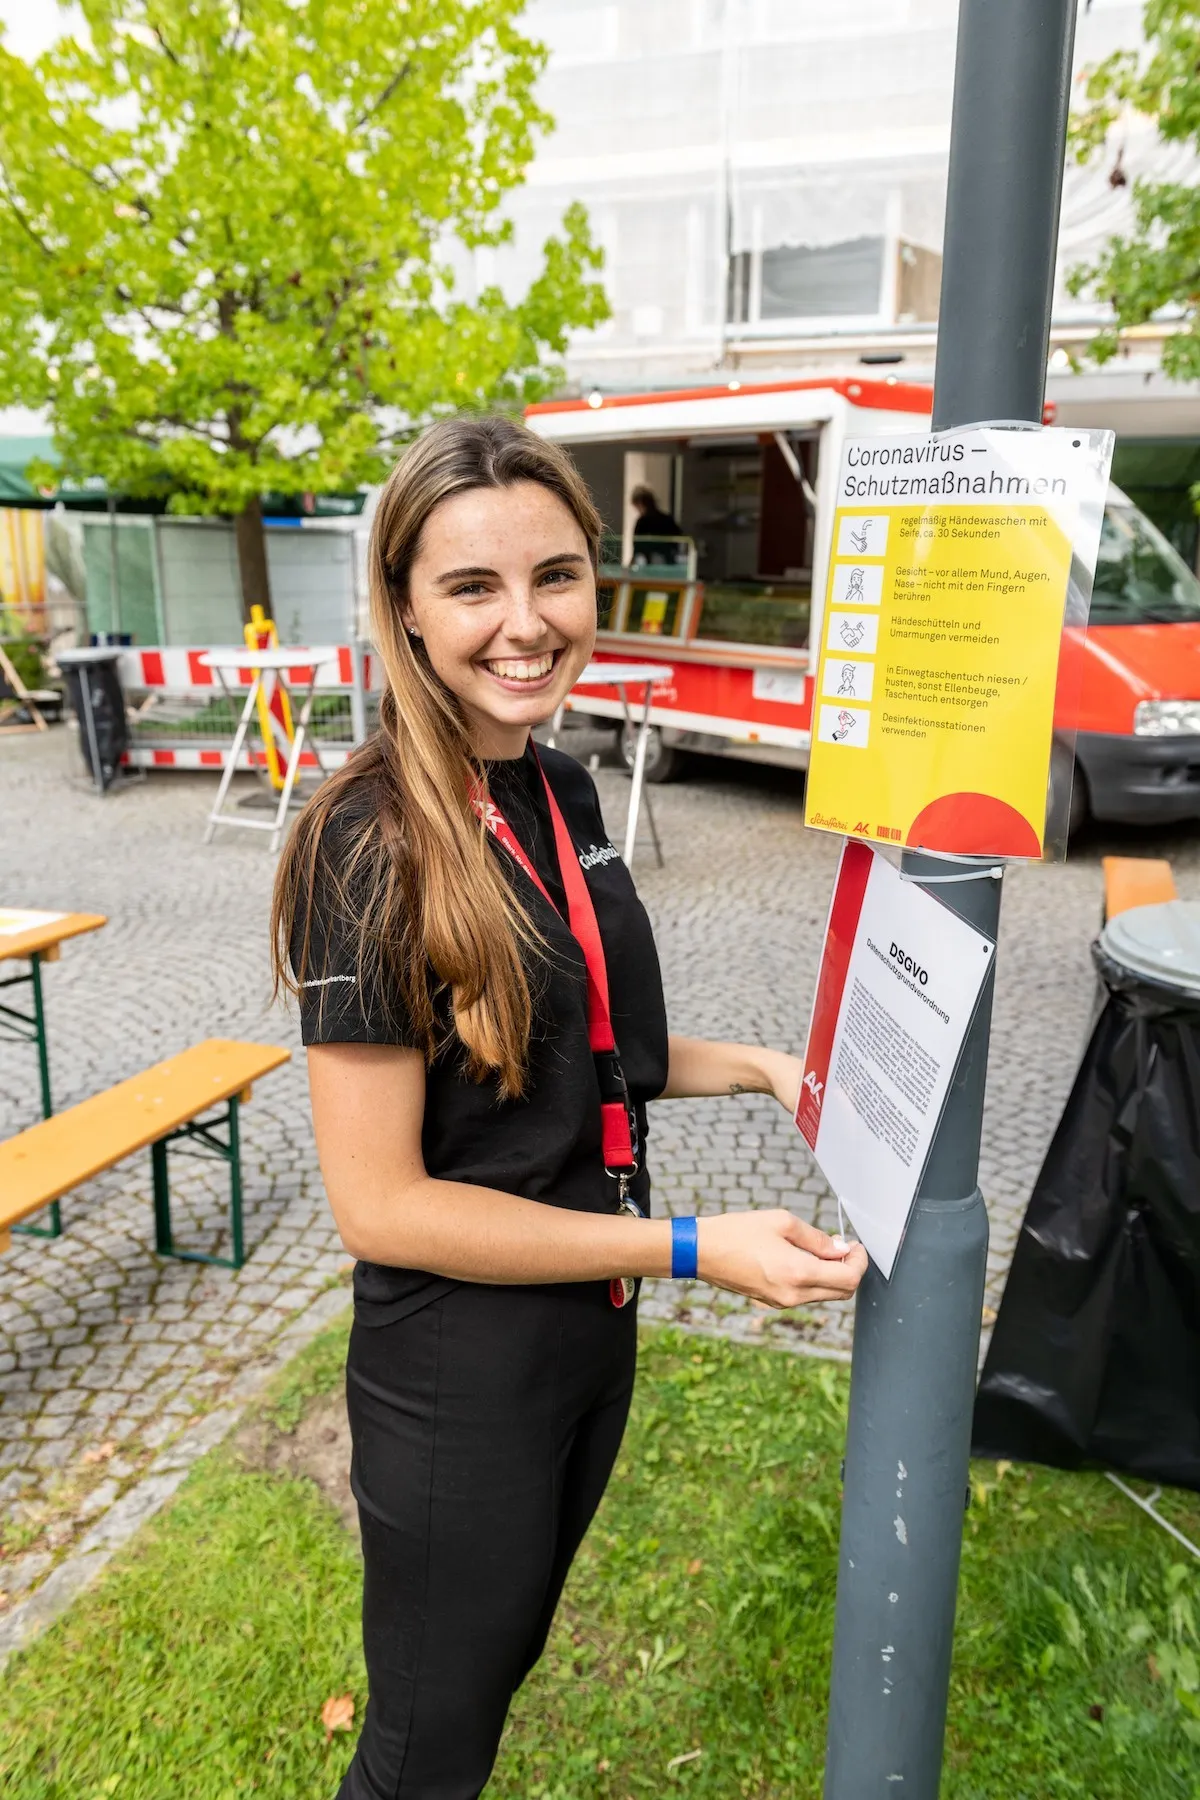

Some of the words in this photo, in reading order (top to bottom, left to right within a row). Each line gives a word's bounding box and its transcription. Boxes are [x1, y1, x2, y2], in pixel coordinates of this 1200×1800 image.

[848, 440, 965, 467] Coronavirus
[844, 470, 1067, 497] Schutzmaßnahmen
[900, 515, 947, 527] regelmäßig
[949, 516, 1026, 526] Händewaschen
[1029, 516, 1048, 527] mit
[900, 528, 922, 539] Seife,
[923, 530, 936, 538] ca.
[938, 528, 950, 538] 30
[951, 528, 1001, 539] Sekunden
[896, 566, 927, 576] Gesicht
[935, 569, 949, 577] vor
[951, 568, 978, 578] allem
[980, 569, 1012, 580] Mund,
[1014, 570, 1050, 582] Augen,
[894, 579, 915, 588] Nase
[923, 580, 946, 590] nicht
[947, 581, 964, 591] mit
[966, 582, 984, 591] den
[986, 582, 1025, 594] Fingern
[893, 591, 931, 602] berühren
[891, 616, 960, 628] Händeschütteln
[962, 621, 981, 630] und
[890, 628, 946, 642] Umarmungen
[949, 633, 1000, 644] vermeiden
[886, 665, 894, 674] in
[896, 666, 984, 682] Einwegtaschentuch
[987, 674, 1020, 685] niesen
[885, 678, 916, 689] husten,
[917, 682, 942, 691] sonst
[944, 683, 1000, 698] Ellenbeuge,
[885, 689, 938, 703] Taschentuch
[940, 695, 988, 709] entsorgen
[882, 713, 986, 732] Desinfektionsstationen
[881, 726, 927, 738] verwenden
[889, 942, 928, 985] DSGVO
[866, 938, 950, 1024] Datenschutzgrundverordnung
